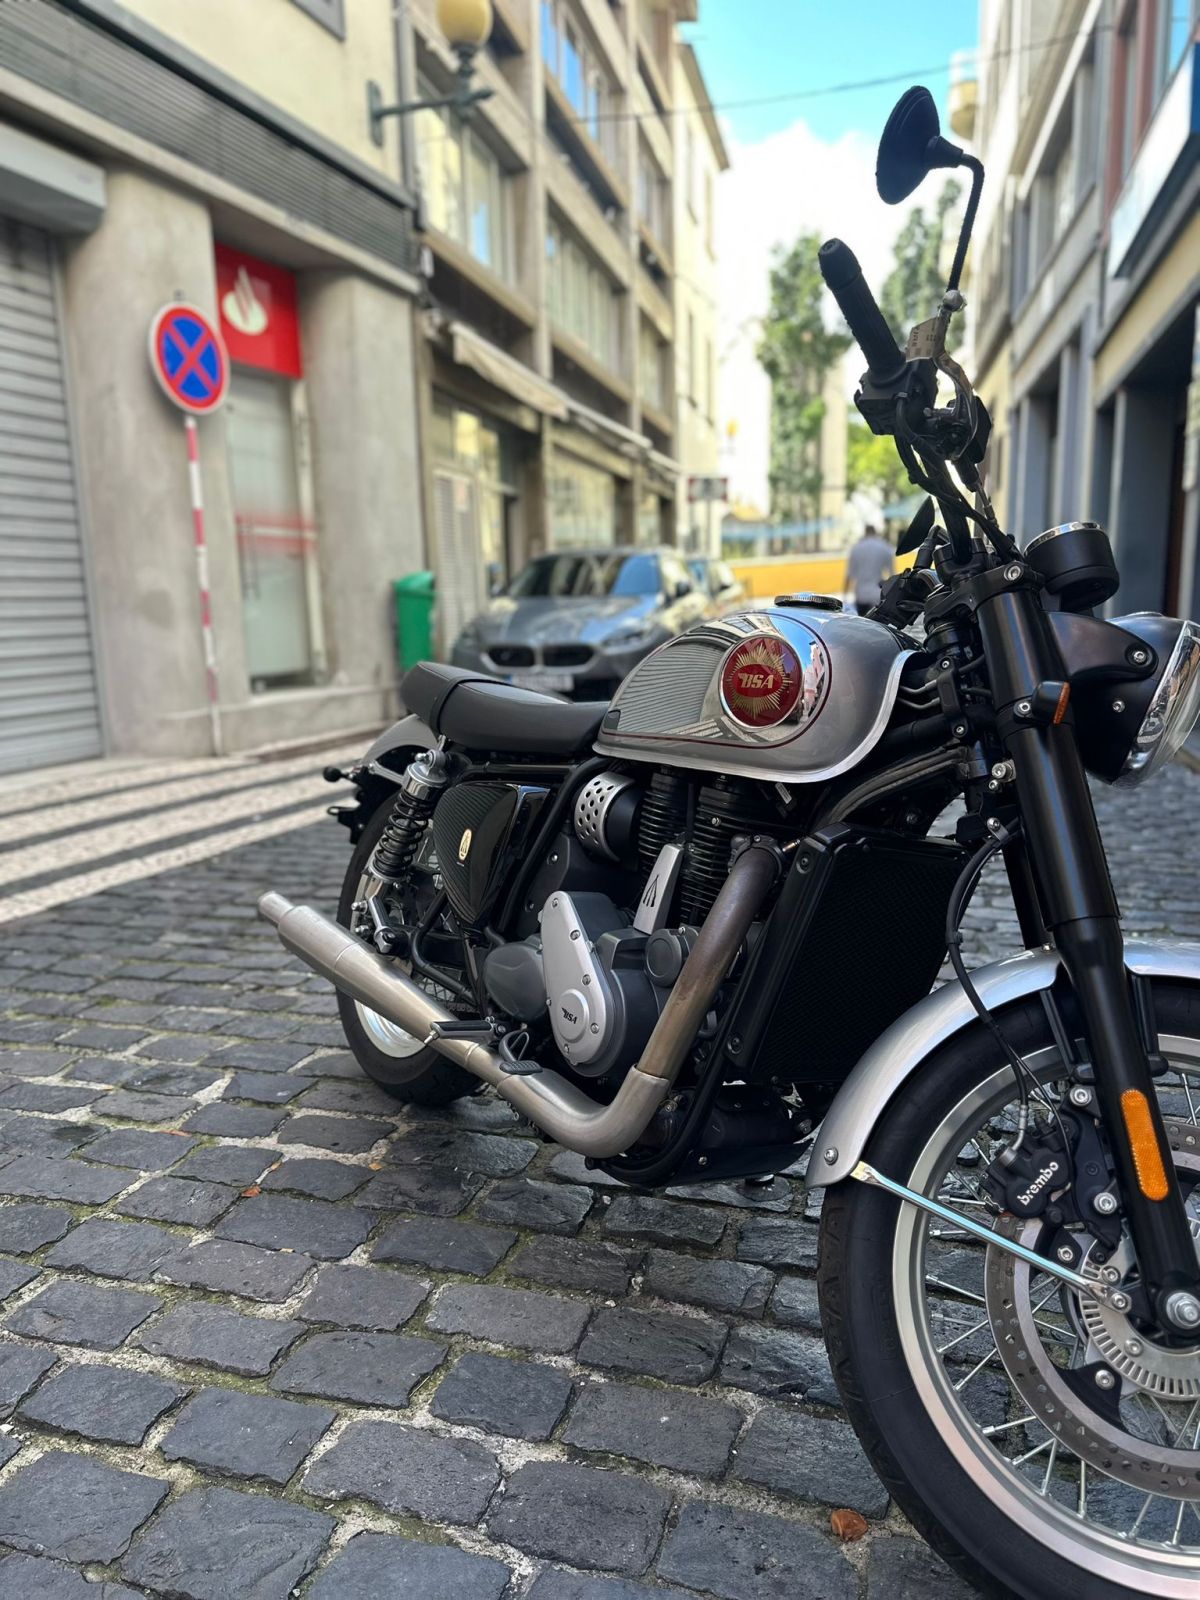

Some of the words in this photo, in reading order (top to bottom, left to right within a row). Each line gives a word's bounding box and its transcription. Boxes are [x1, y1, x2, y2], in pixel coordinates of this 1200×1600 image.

[737, 672, 774, 689] BSA
[561, 1007, 578, 1025] BSA
[1016, 1161, 1059, 1206] brembo
